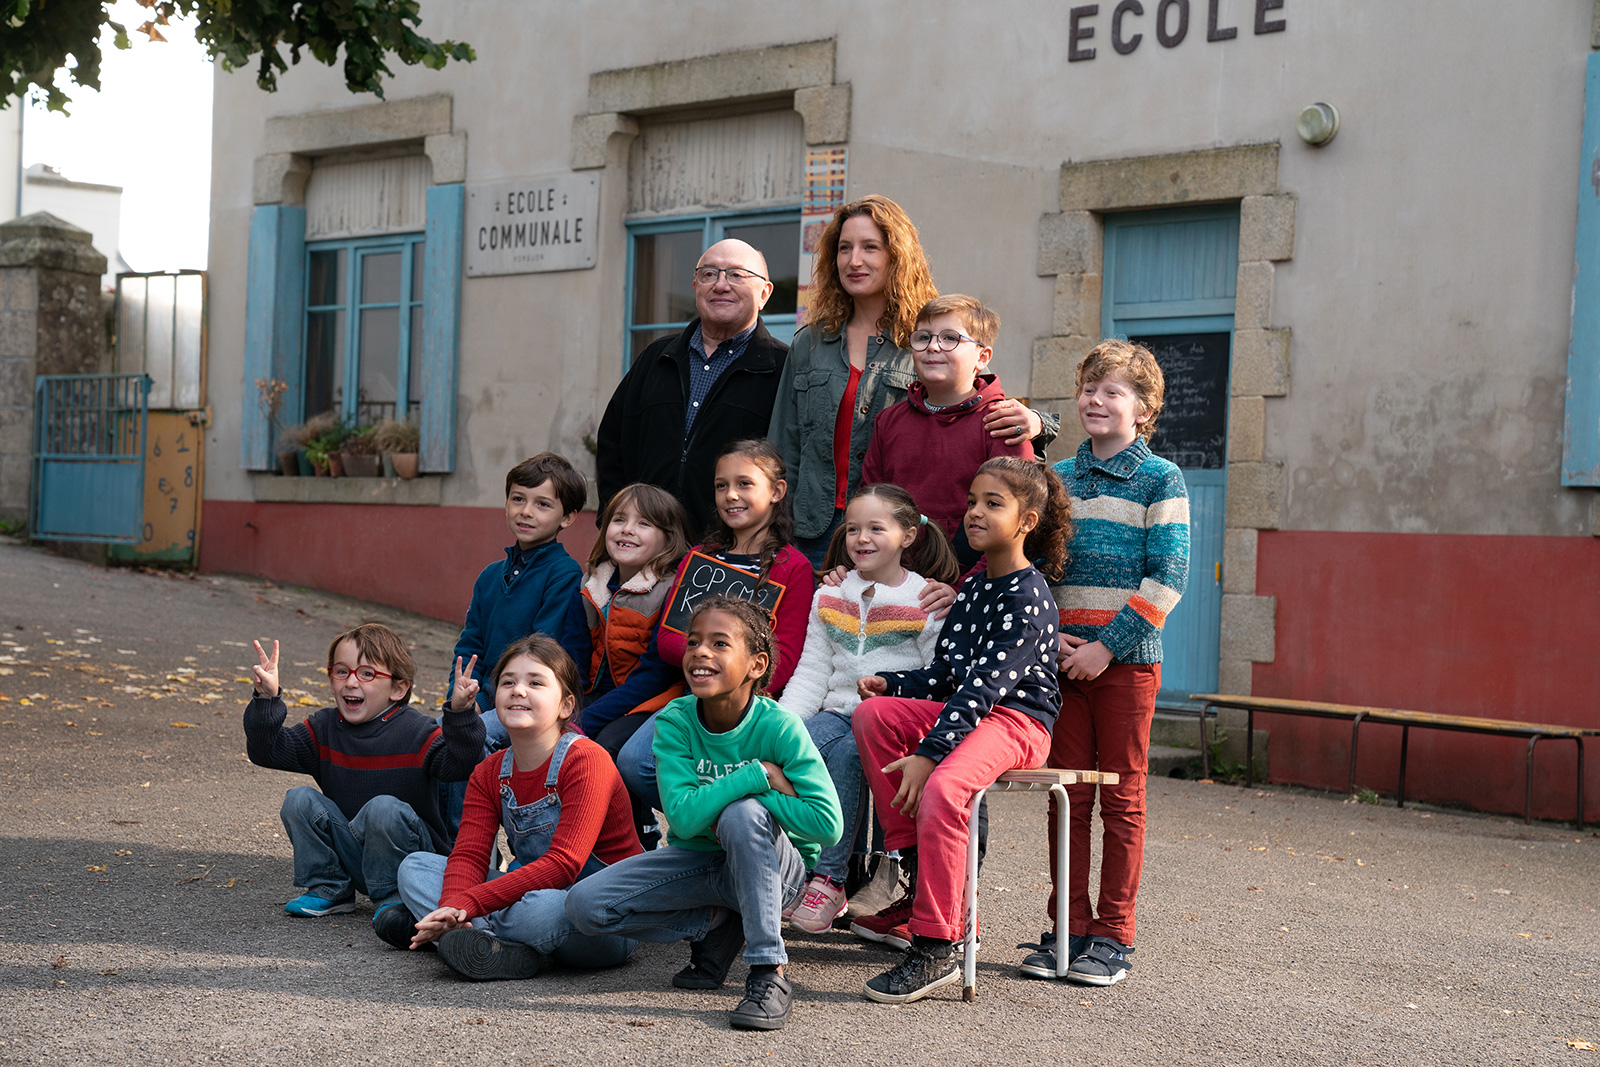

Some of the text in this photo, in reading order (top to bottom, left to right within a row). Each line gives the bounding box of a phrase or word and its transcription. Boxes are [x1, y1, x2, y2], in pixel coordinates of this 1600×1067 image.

[1068, 0, 1286, 62] ECOLE
[508, 188, 555, 215] ECOLE
[478, 217, 583, 251] COMMUNALE
[184, 465, 193, 488] 8
[692, 564, 726, 592] CP
